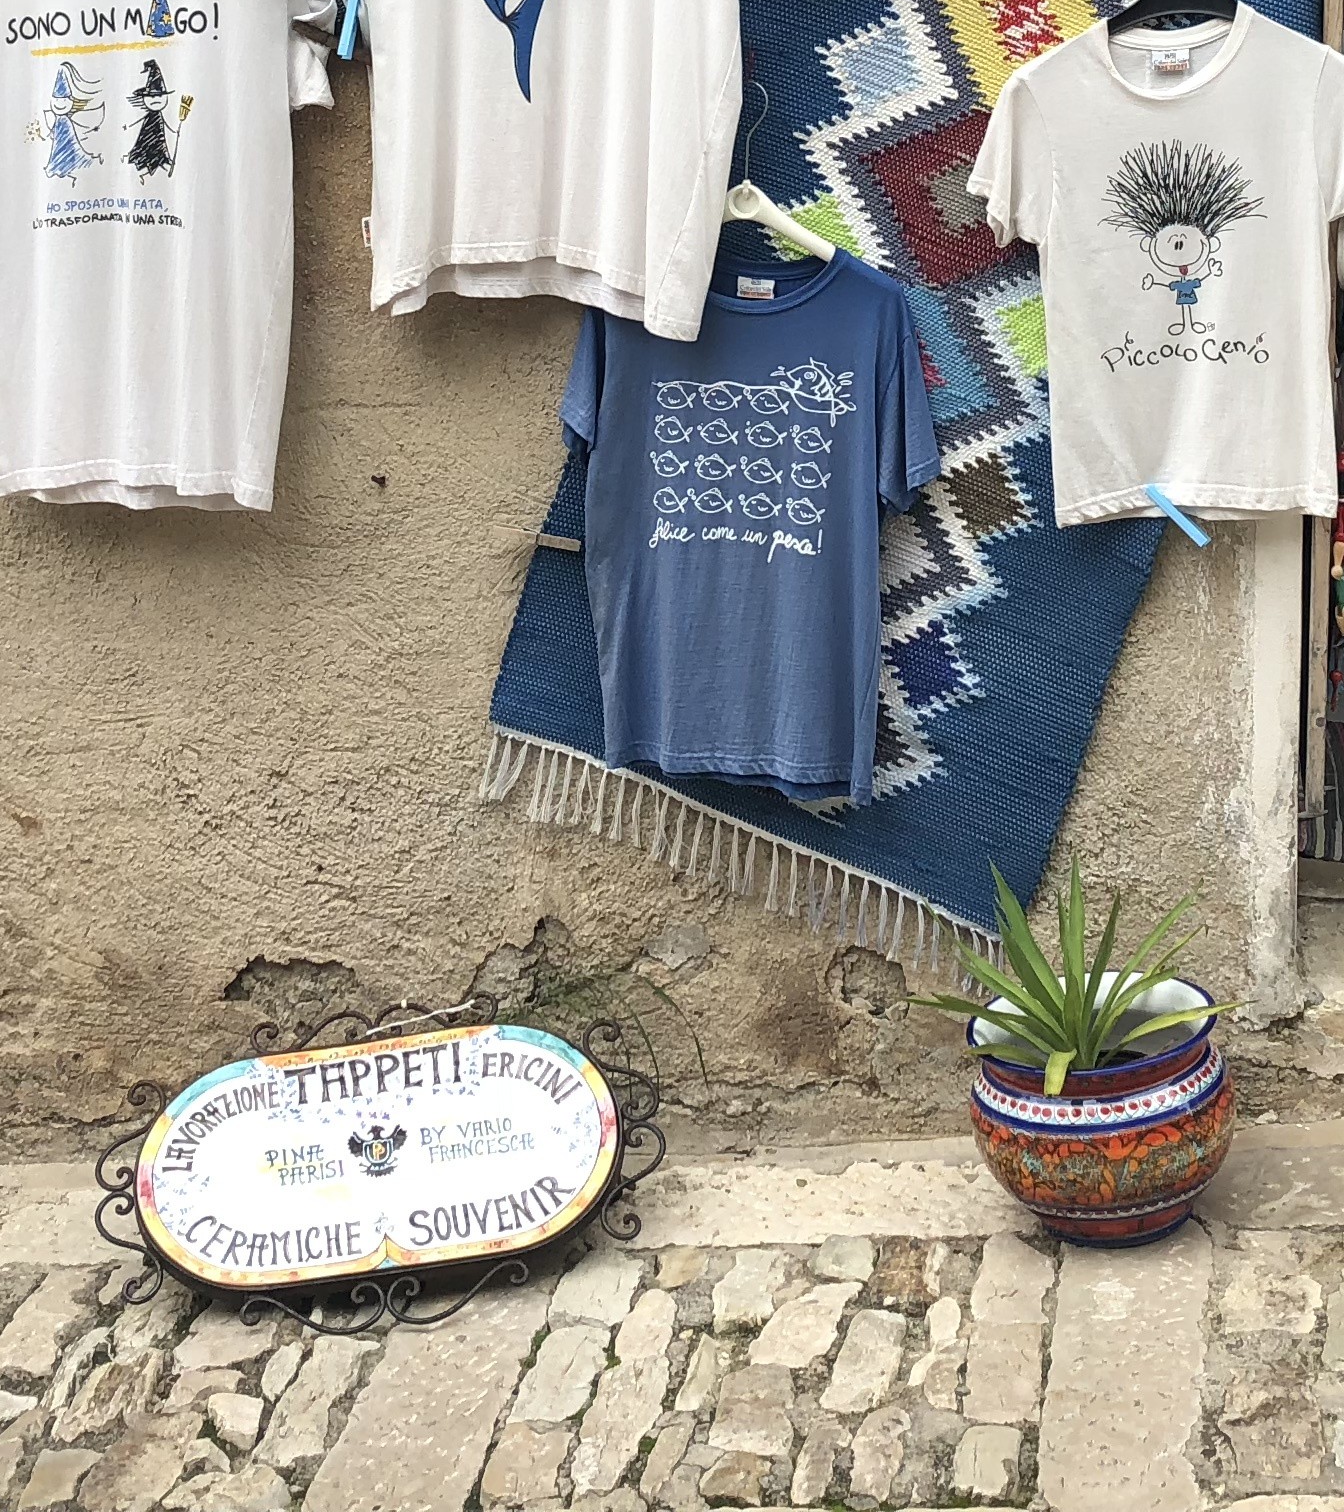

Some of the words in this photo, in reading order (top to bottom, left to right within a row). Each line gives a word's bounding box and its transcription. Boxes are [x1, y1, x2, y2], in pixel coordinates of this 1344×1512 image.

[6, 12, 71, 44] SONO
[81, 7, 116, 37] UN
[47, 202, 61, 213] HO
[64, 197, 115, 211] SPOSATO
[133, 213, 155, 226] UNA
[702, 526, 737, 540] come
[741, 529, 768, 545] un
[767, 529, 823, 563] pesce!
[162, 1079, 281, 1174] LAVORAZIONE
[284, 1040, 462, 1106] TAPPETI
[482, 1051, 583, 1105] ERICINI
[420, 1126, 447, 1146] BY
[456, 1117, 513, 1138] VARIO
[264, 1144, 325, 1168] PINA
[428, 1133, 535, 1164] FRANCESCA
[278, 1159, 346, 1186] PARISI
[186, 1214, 362, 1267] CERAMICHE
[408, 1175, 576, 1247] SOUVENIR
